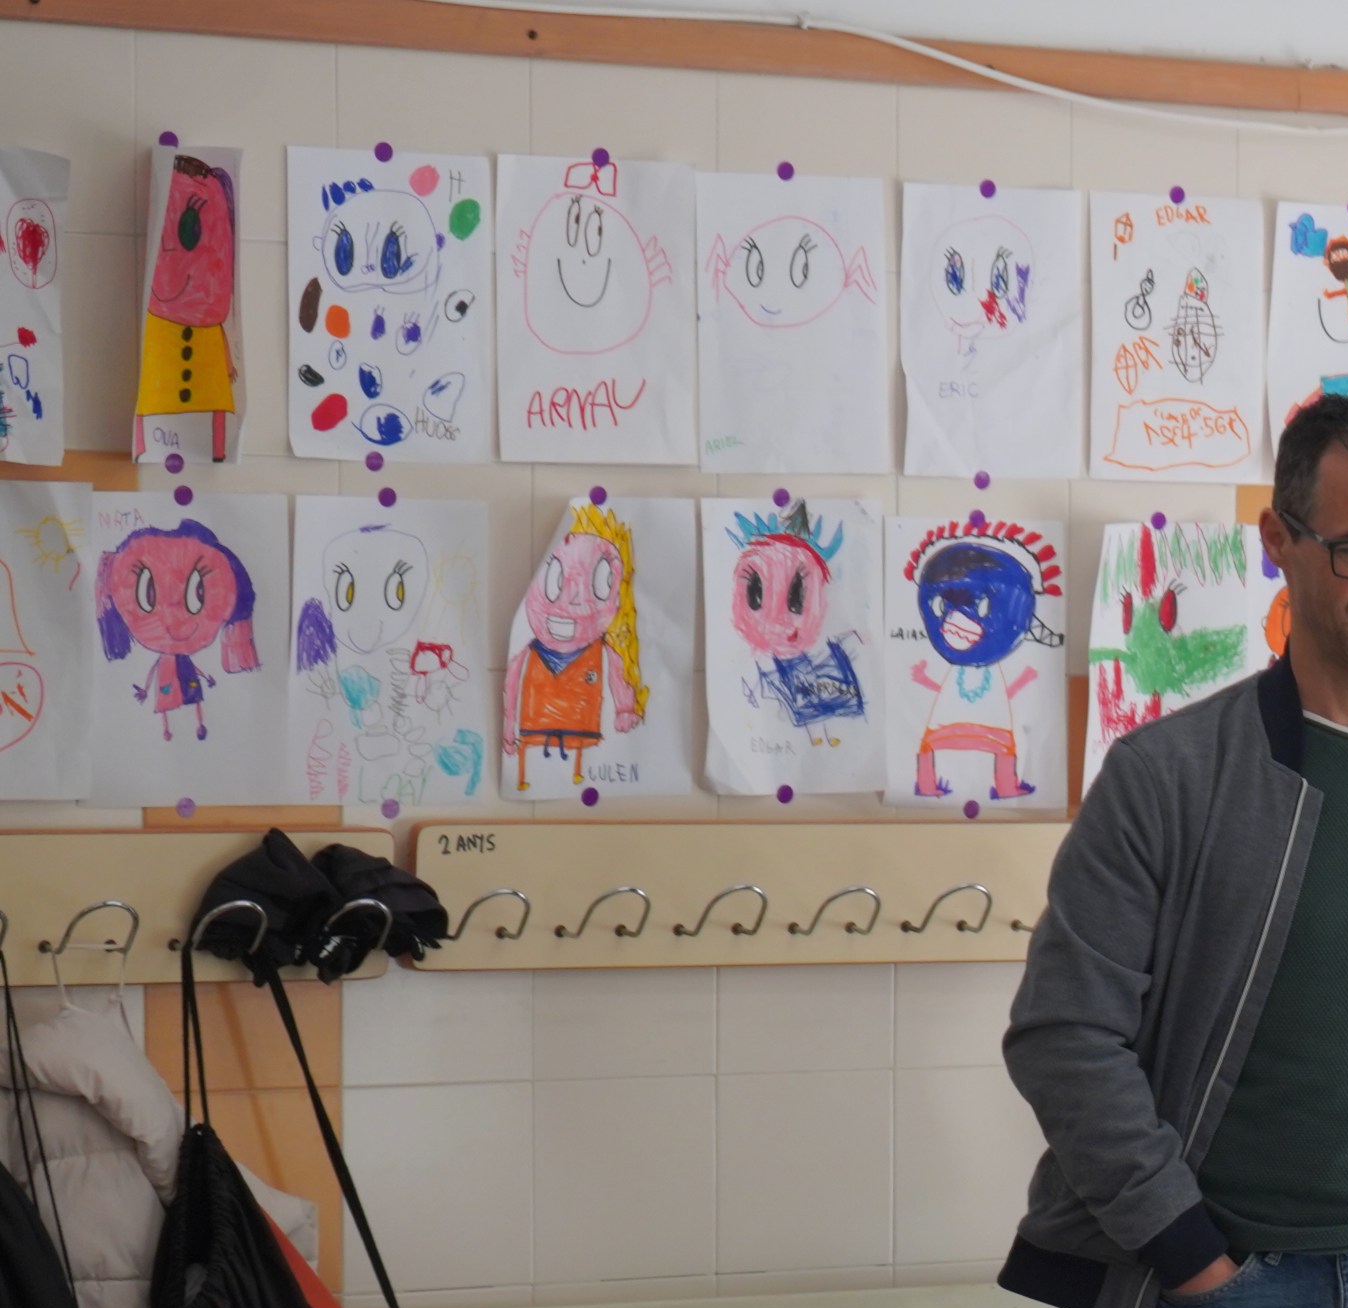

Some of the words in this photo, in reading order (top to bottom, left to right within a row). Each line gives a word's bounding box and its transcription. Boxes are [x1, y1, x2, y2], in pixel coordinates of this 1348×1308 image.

[1155, 204, 1212, 227] EDGAR
[938, 380, 979, 399] ERIC
[526, 376, 647, 431] ARNAU
[438, 834, 451, 855] 2
[455, 833, 496, 854] ANYS
